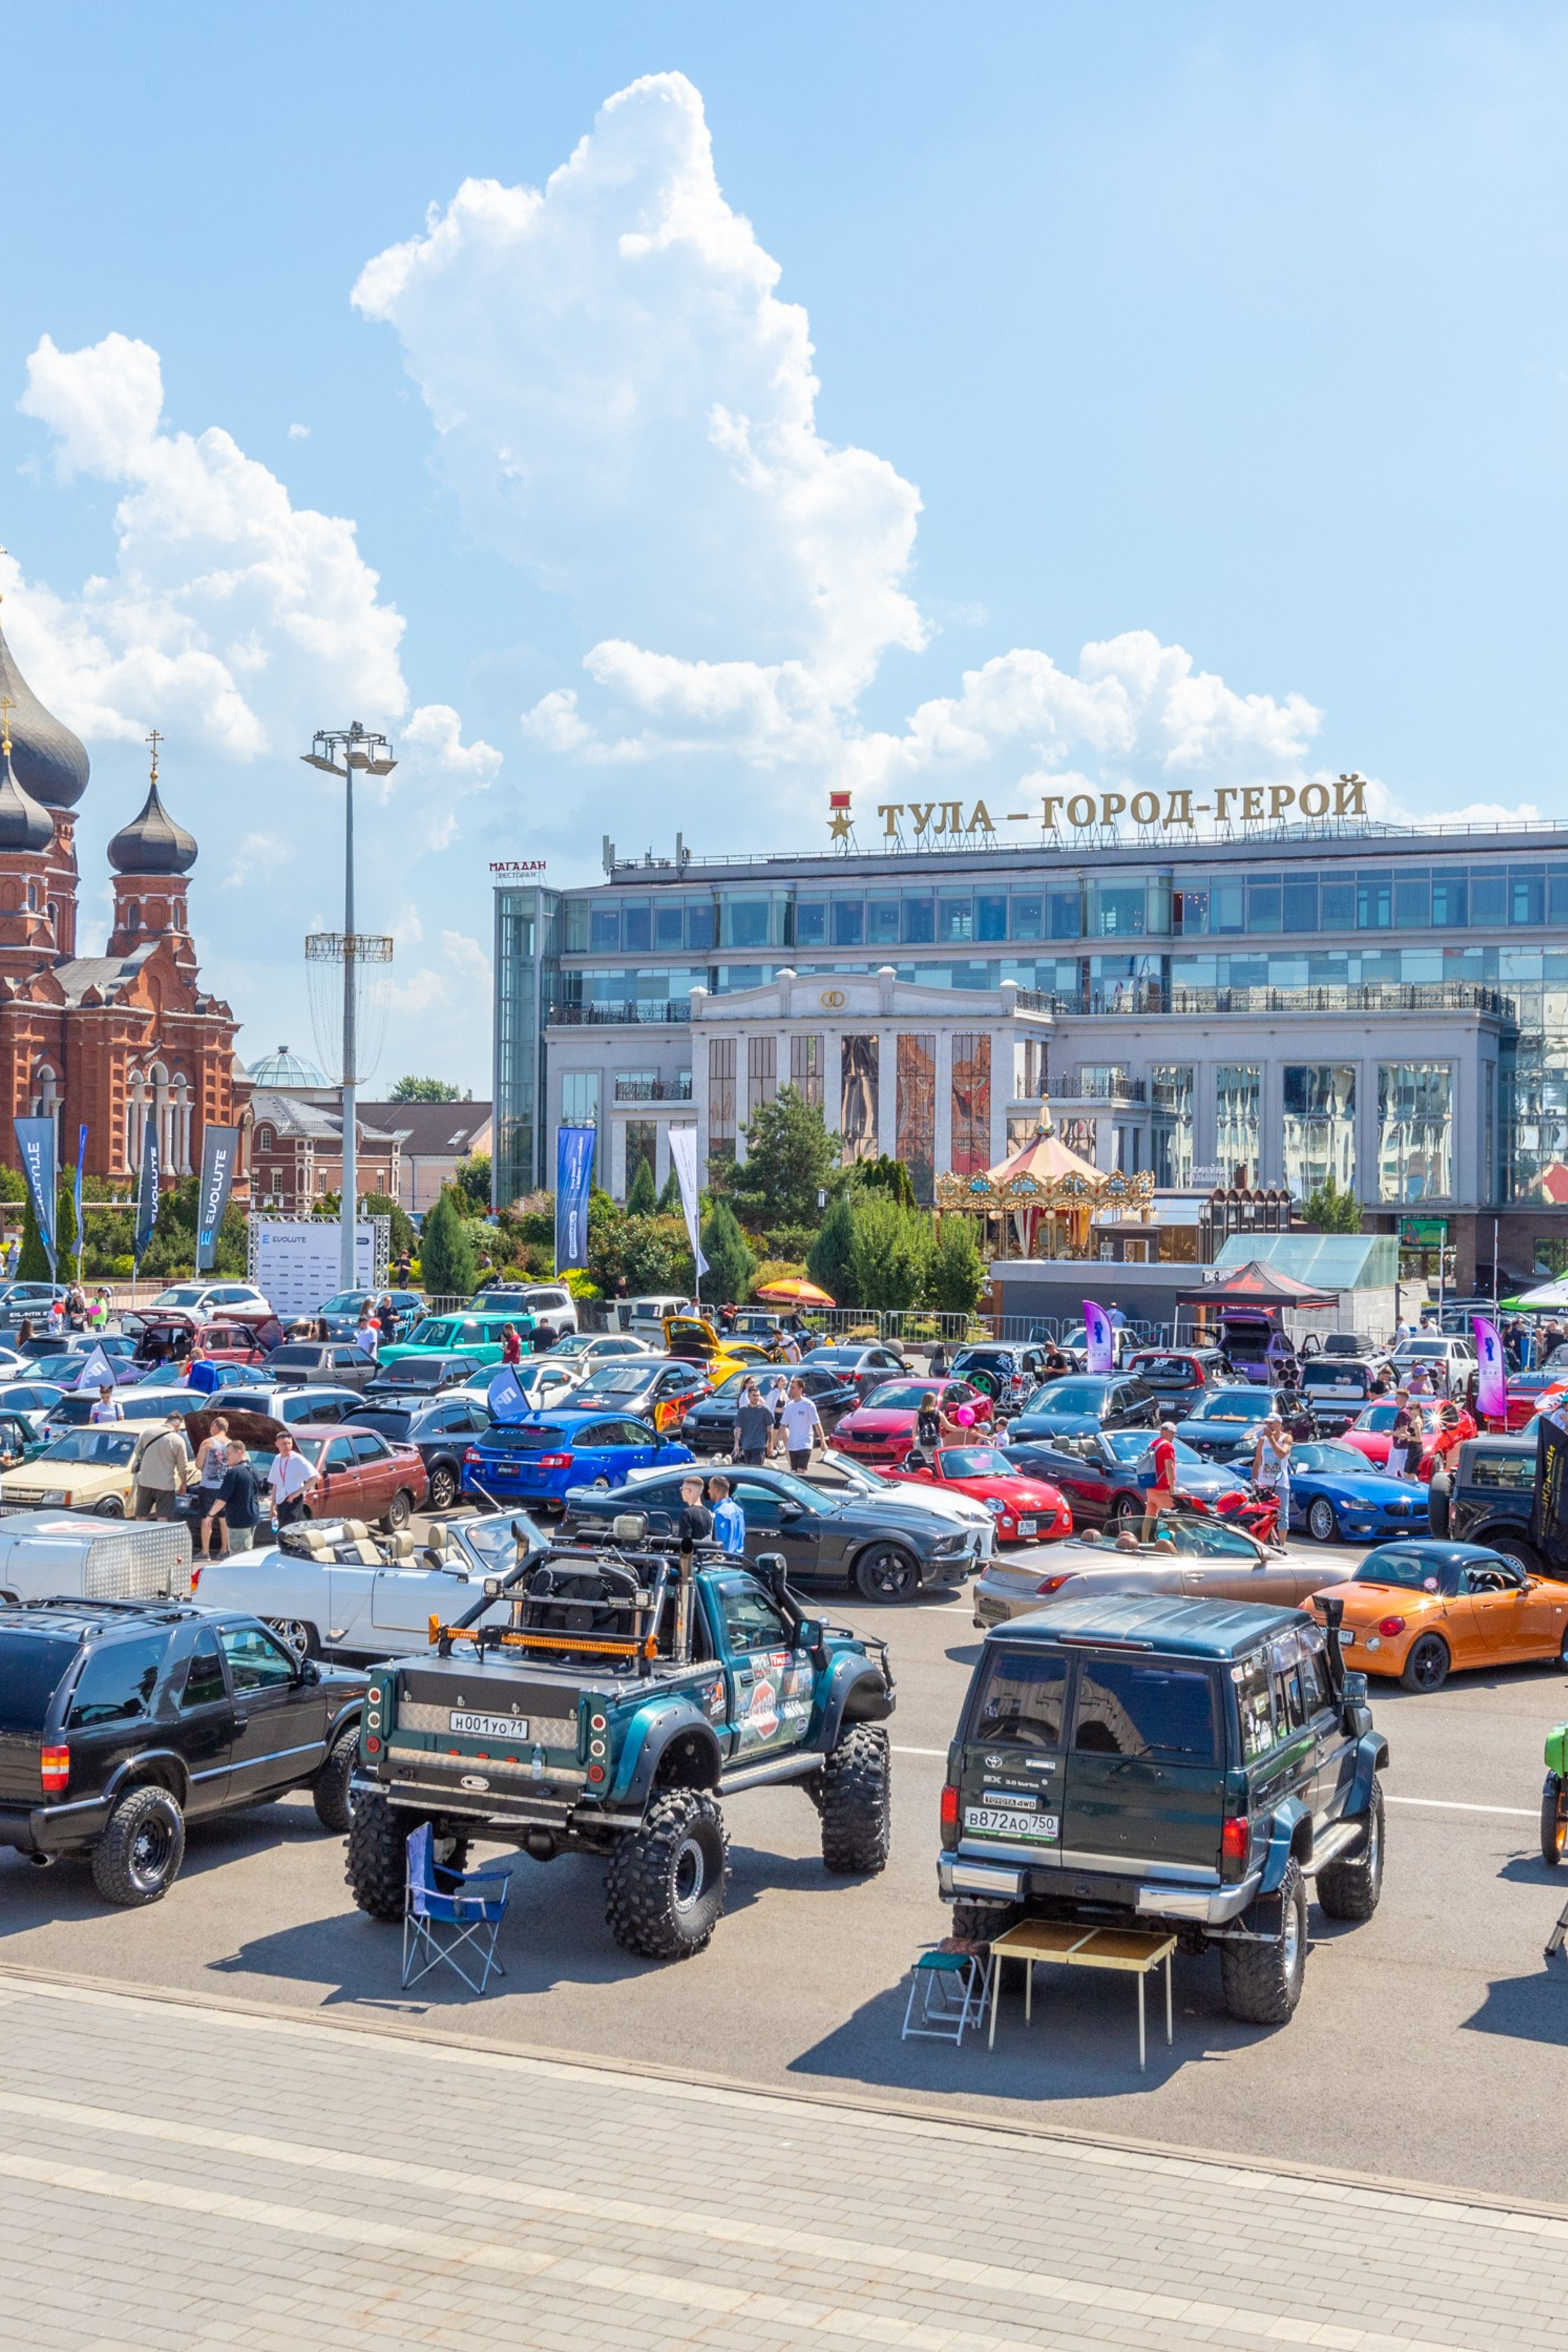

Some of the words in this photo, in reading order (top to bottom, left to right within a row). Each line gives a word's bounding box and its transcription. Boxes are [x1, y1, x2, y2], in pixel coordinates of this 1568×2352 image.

[878, 800, 997, 836] ТУЛА
[489, 861, 546, 871] МАГАДАН
[205, 1149, 227, 1224] EVOLUTE
[986, 1796, 1015, 1805] TOYOTA
